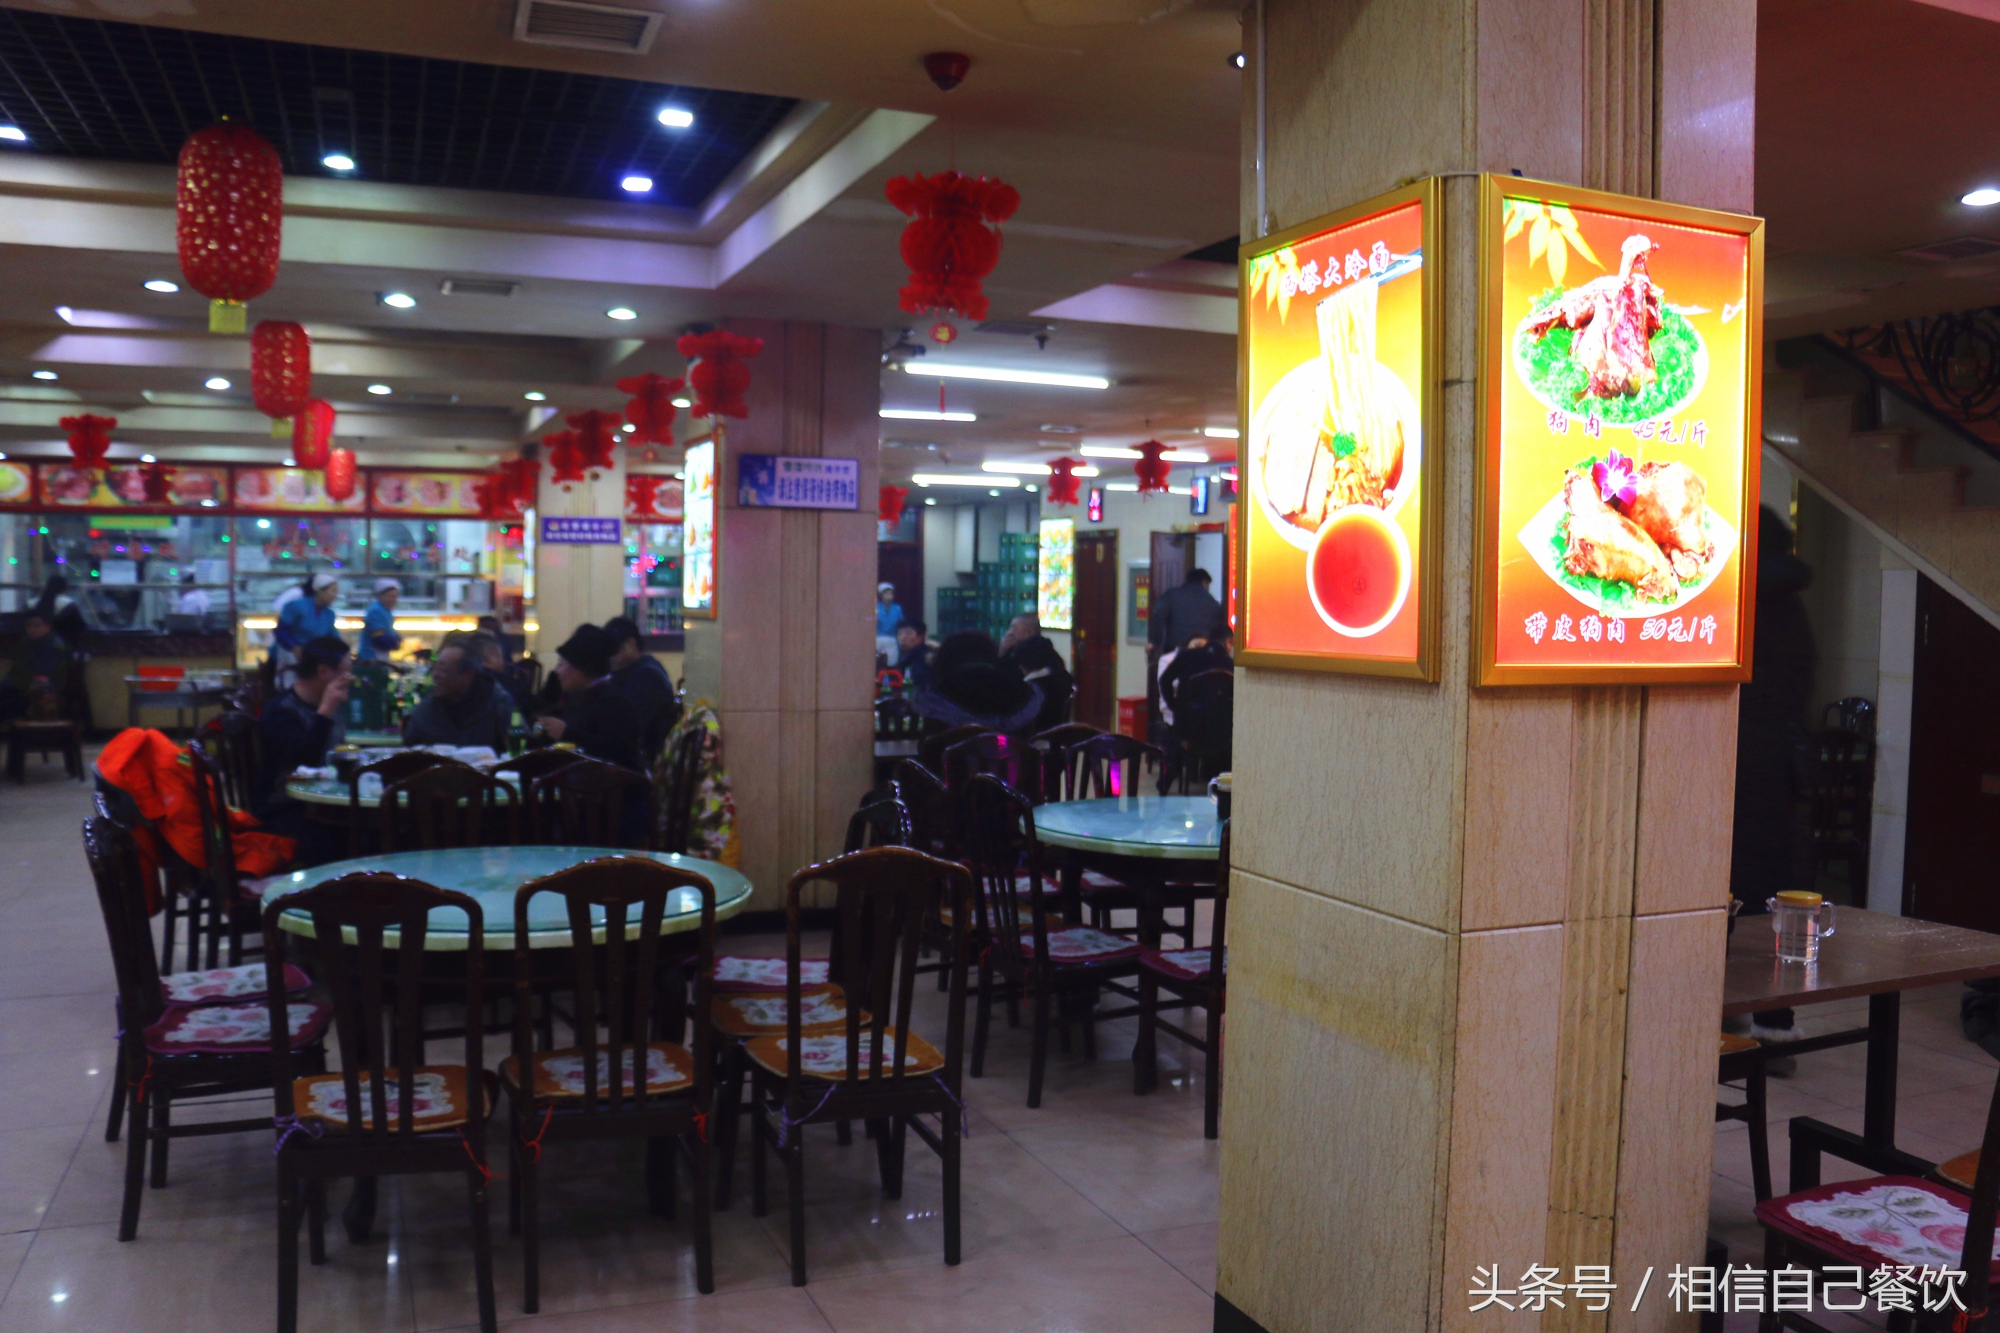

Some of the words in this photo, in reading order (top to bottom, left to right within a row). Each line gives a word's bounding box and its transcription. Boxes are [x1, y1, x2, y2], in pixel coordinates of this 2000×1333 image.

[1632, 419, 1708, 448] 45元/斤
[1524, 611, 1625, 644] 带皮狗肉
[1639, 615, 1717, 645] 50元/斤
